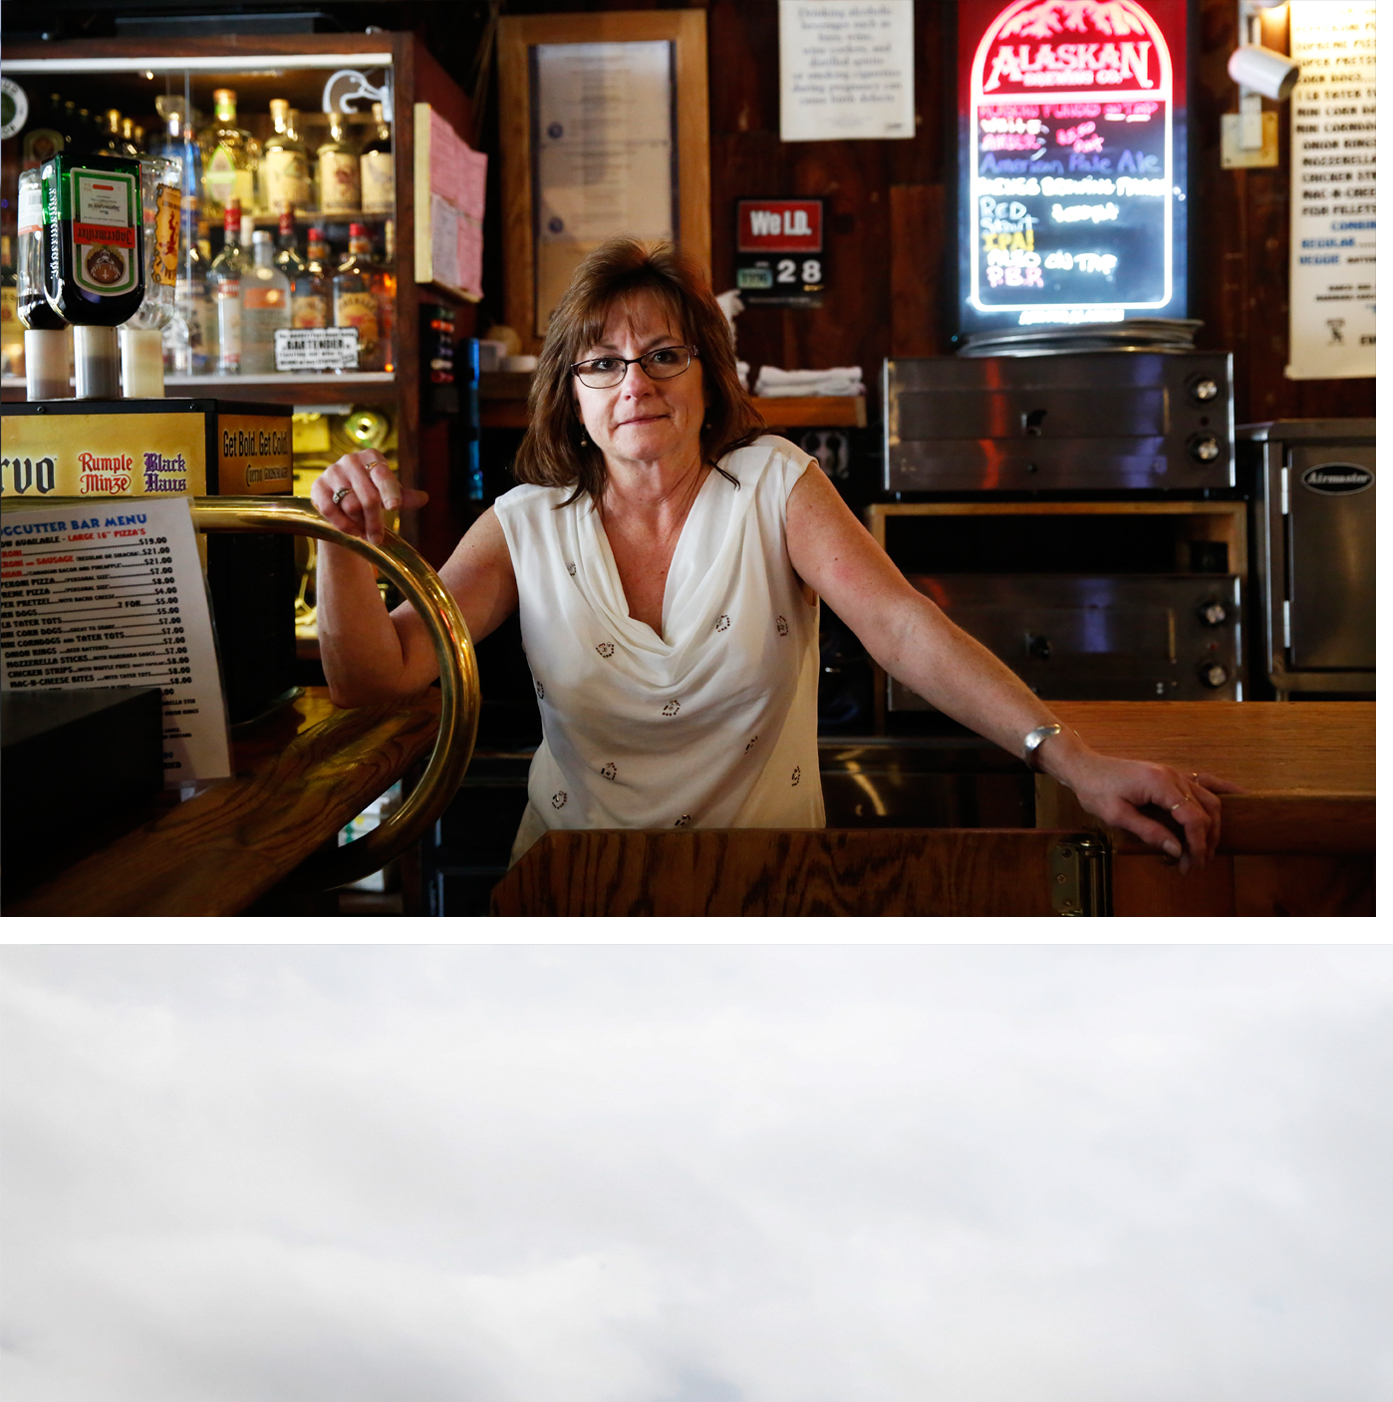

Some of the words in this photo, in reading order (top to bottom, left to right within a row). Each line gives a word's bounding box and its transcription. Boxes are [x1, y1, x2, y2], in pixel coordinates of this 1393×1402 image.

[983, 41, 1154, 92] ALASKAN
[750, 210, 782, 236] We
[224, 430, 237, 457] Get
[238, 430, 258, 457] Bold.
[259, 430, 272, 456] Get
[78, 452, 133, 474] Rumple
[144, 452, 187, 473] Black
[80, 473, 132, 494] Minze
[144, 472, 187, 493] Haus
[70, 518, 100, 530] BAR
[104, 514, 147, 528] MENU
[16, 536, 60, 546] AVAILABLE
[68, 532, 94, 542] LARGE
[14, 619, 39, 628] TATER
[76, 634, 102, 642] TATER
[8, 669, 43, 678] CHICKEN
[45, 666, 73, 675] STRIPS
